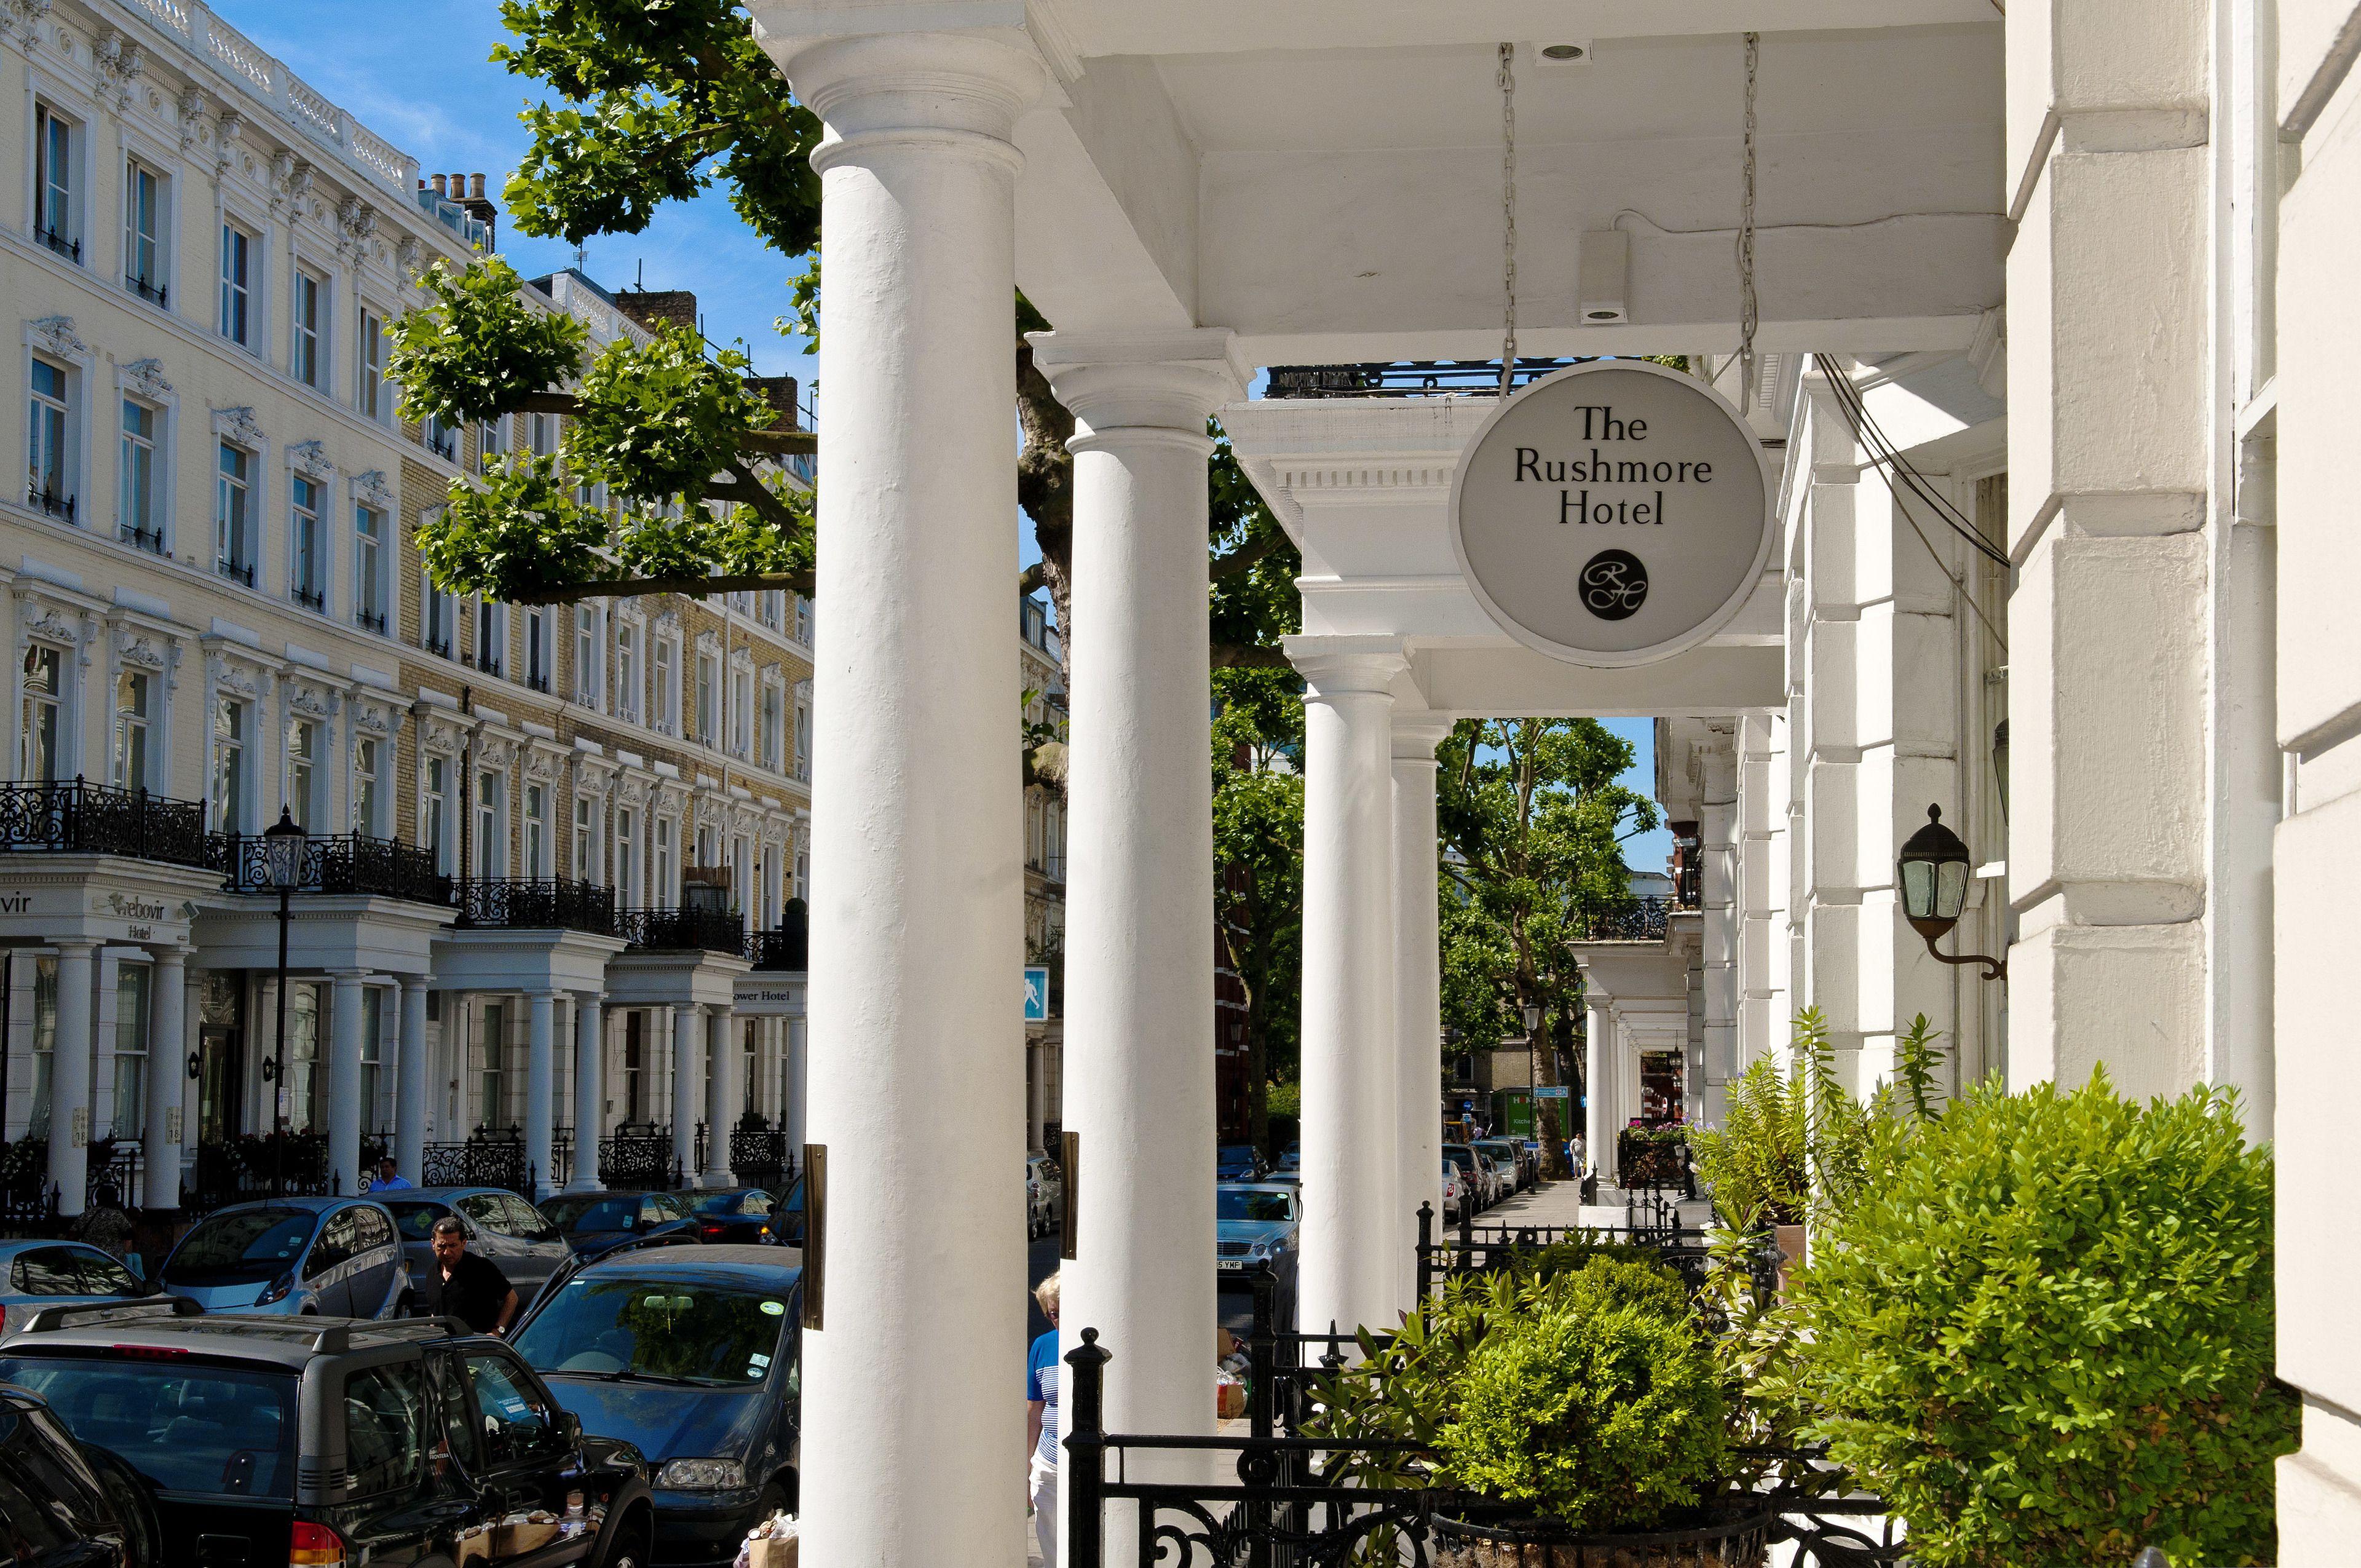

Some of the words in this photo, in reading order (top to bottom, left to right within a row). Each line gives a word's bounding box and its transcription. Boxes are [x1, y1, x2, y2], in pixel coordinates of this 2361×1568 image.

[1573, 405, 1648, 441] The
[1514, 447, 1712, 483] Rushmore
[1559, 489, 1664, 526] Hotel
[128, 924, 151, 940] Hotel
[761, 991, 789, 1000] Hotel
